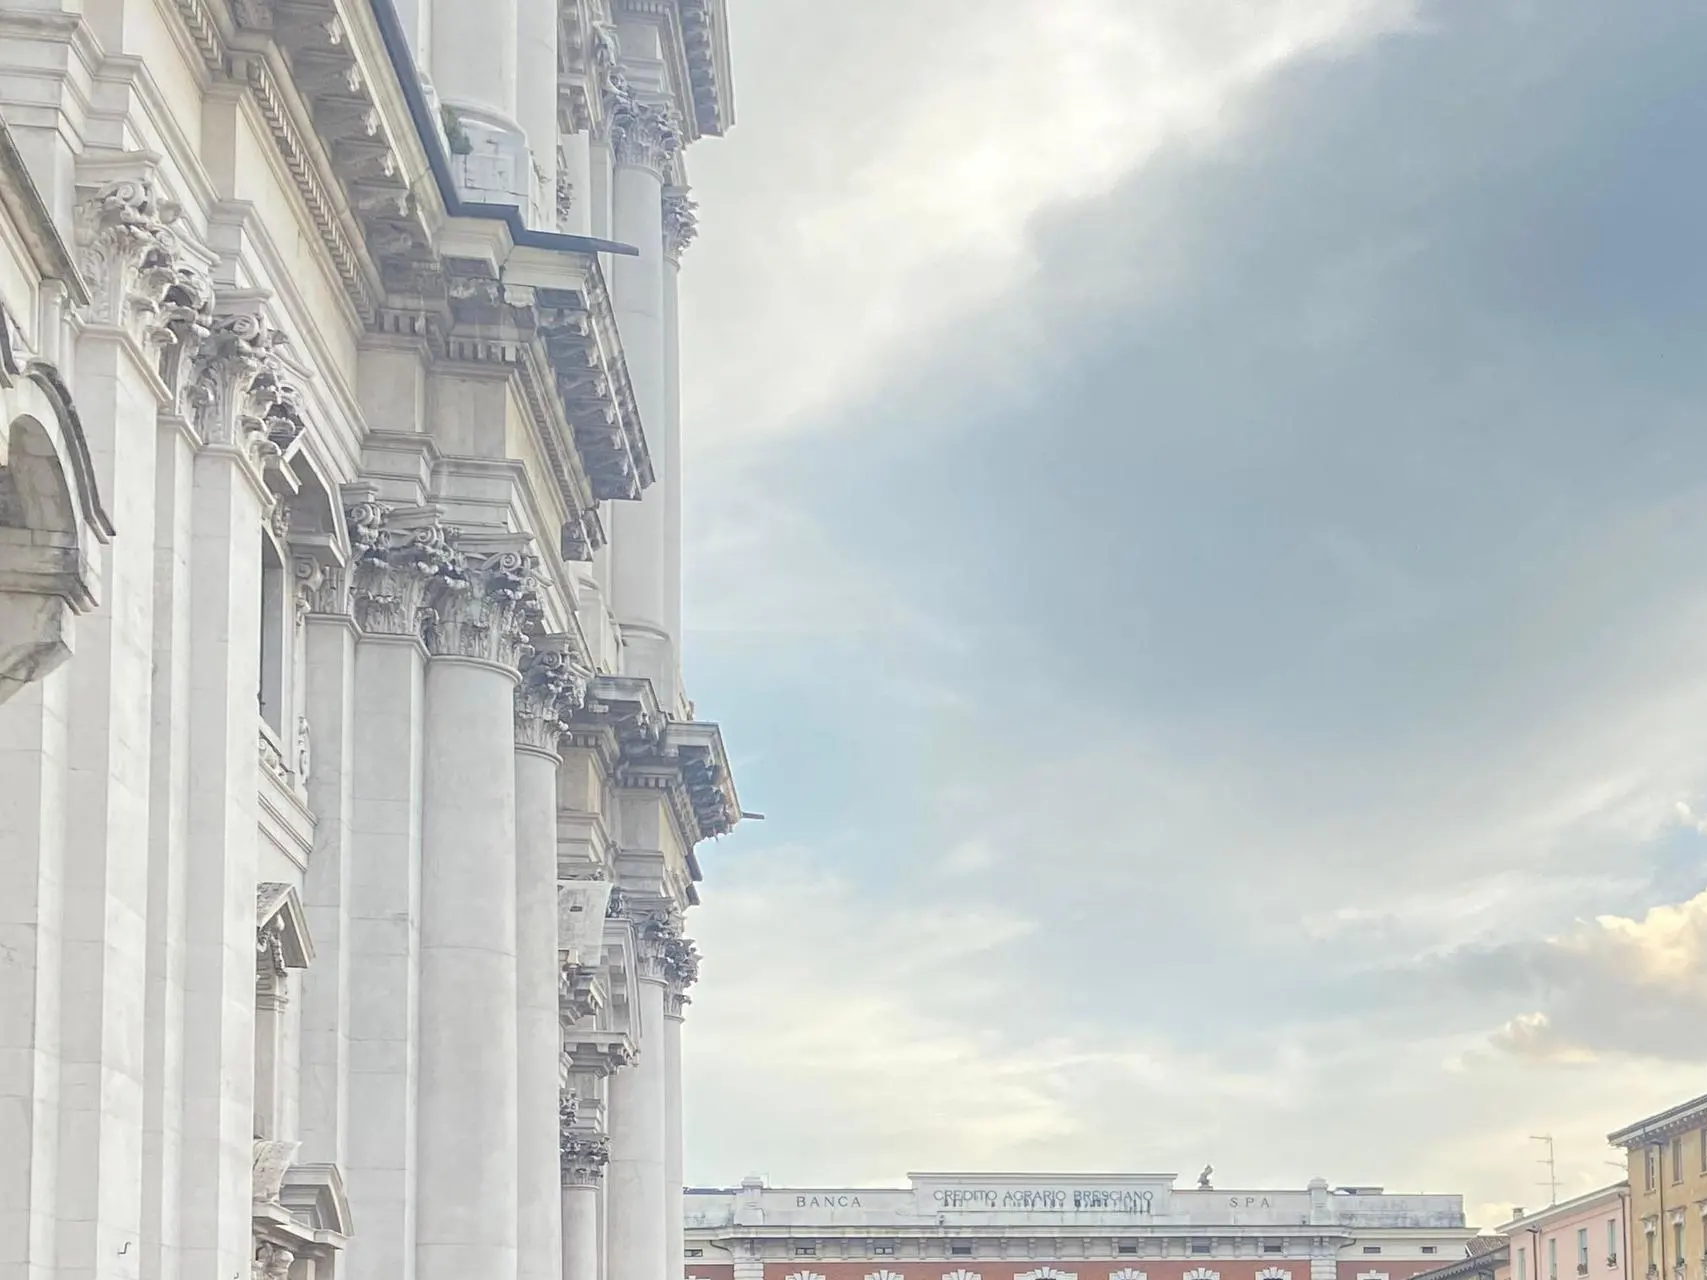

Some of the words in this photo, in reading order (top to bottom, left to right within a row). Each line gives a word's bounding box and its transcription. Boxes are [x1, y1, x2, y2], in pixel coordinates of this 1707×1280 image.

[796, 1195, 862, 1208] BANCA
[933, 1190, 998, 1201] CREDITO
[1003, 1190, 1067, 1201] AGRARIO
[1073, 1190, 1154, 1201] BRESCIANO
